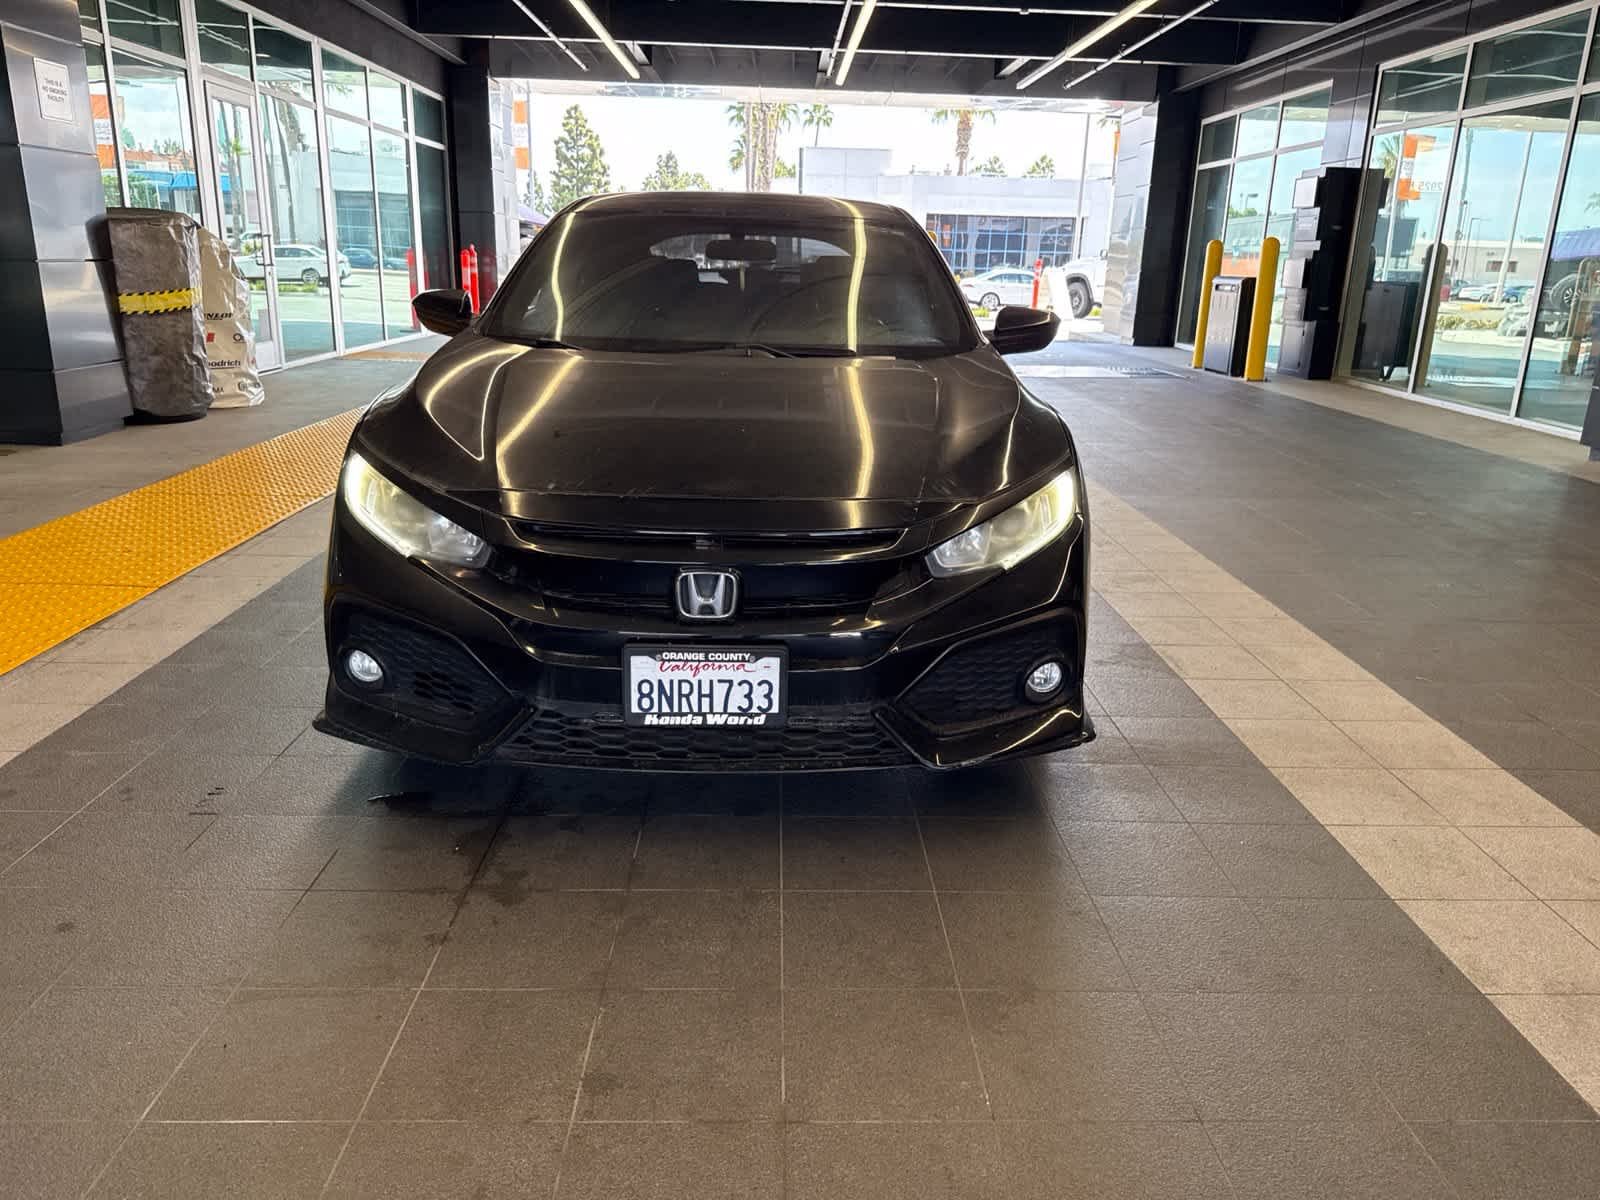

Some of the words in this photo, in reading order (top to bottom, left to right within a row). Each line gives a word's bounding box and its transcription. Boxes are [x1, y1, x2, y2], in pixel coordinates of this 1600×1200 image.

[662, 652, 705, 660] ORANGE
[708, 652, 750, 661] COUNTY
[659, 662, 756, 678] California
[637, 679, 774, 713] 8NRH733
[644, 714, 702, 726] Honda
